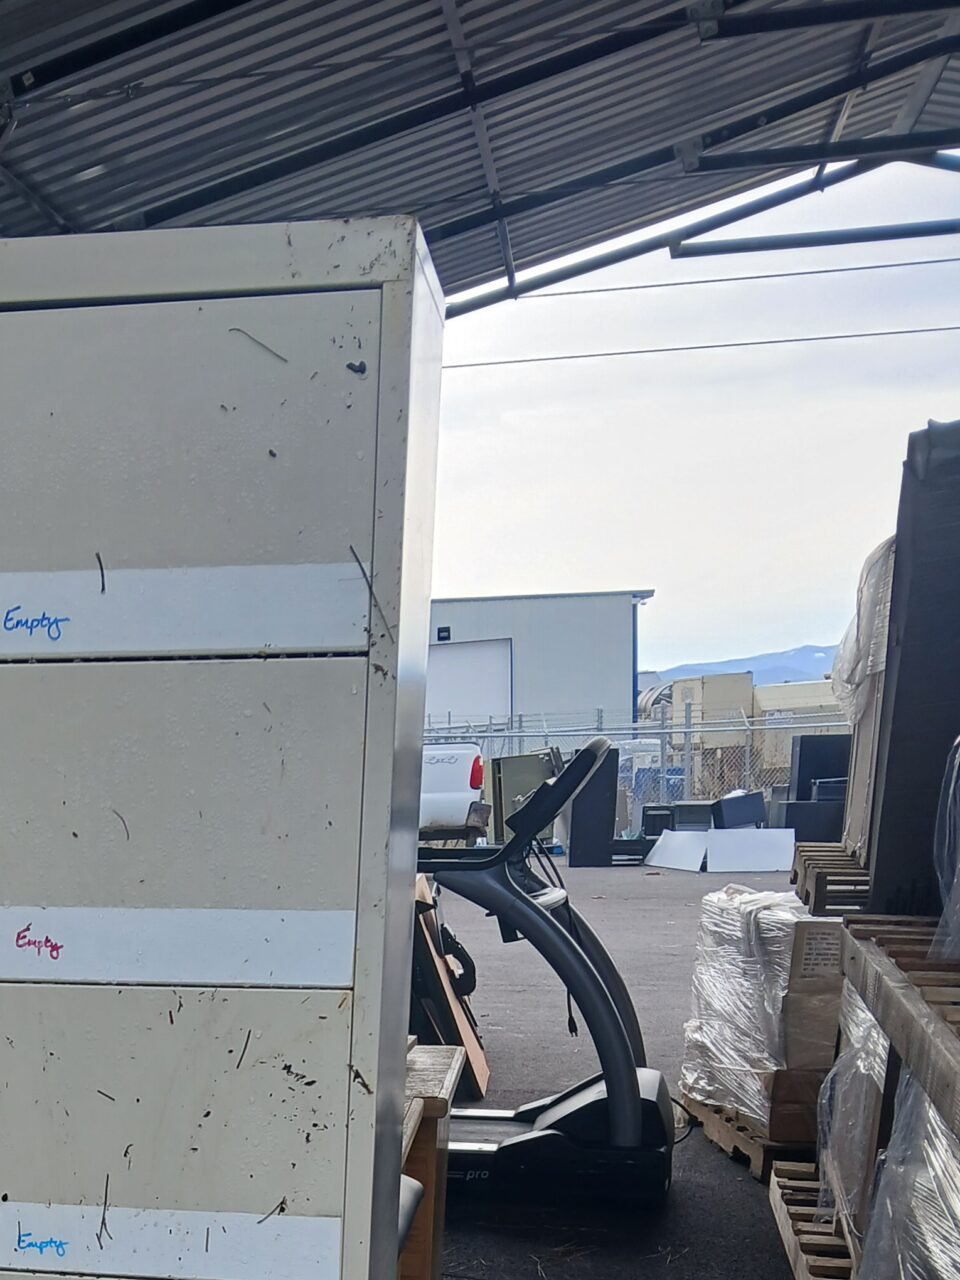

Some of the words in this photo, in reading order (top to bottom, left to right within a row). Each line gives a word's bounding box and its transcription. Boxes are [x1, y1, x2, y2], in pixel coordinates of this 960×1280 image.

[3, 606, 70, 641] Empty
[16, 923, 63, 959] Empty
[466, 1170, 489, 1181] pro
[19, 1233, 69, 1257] Empty
